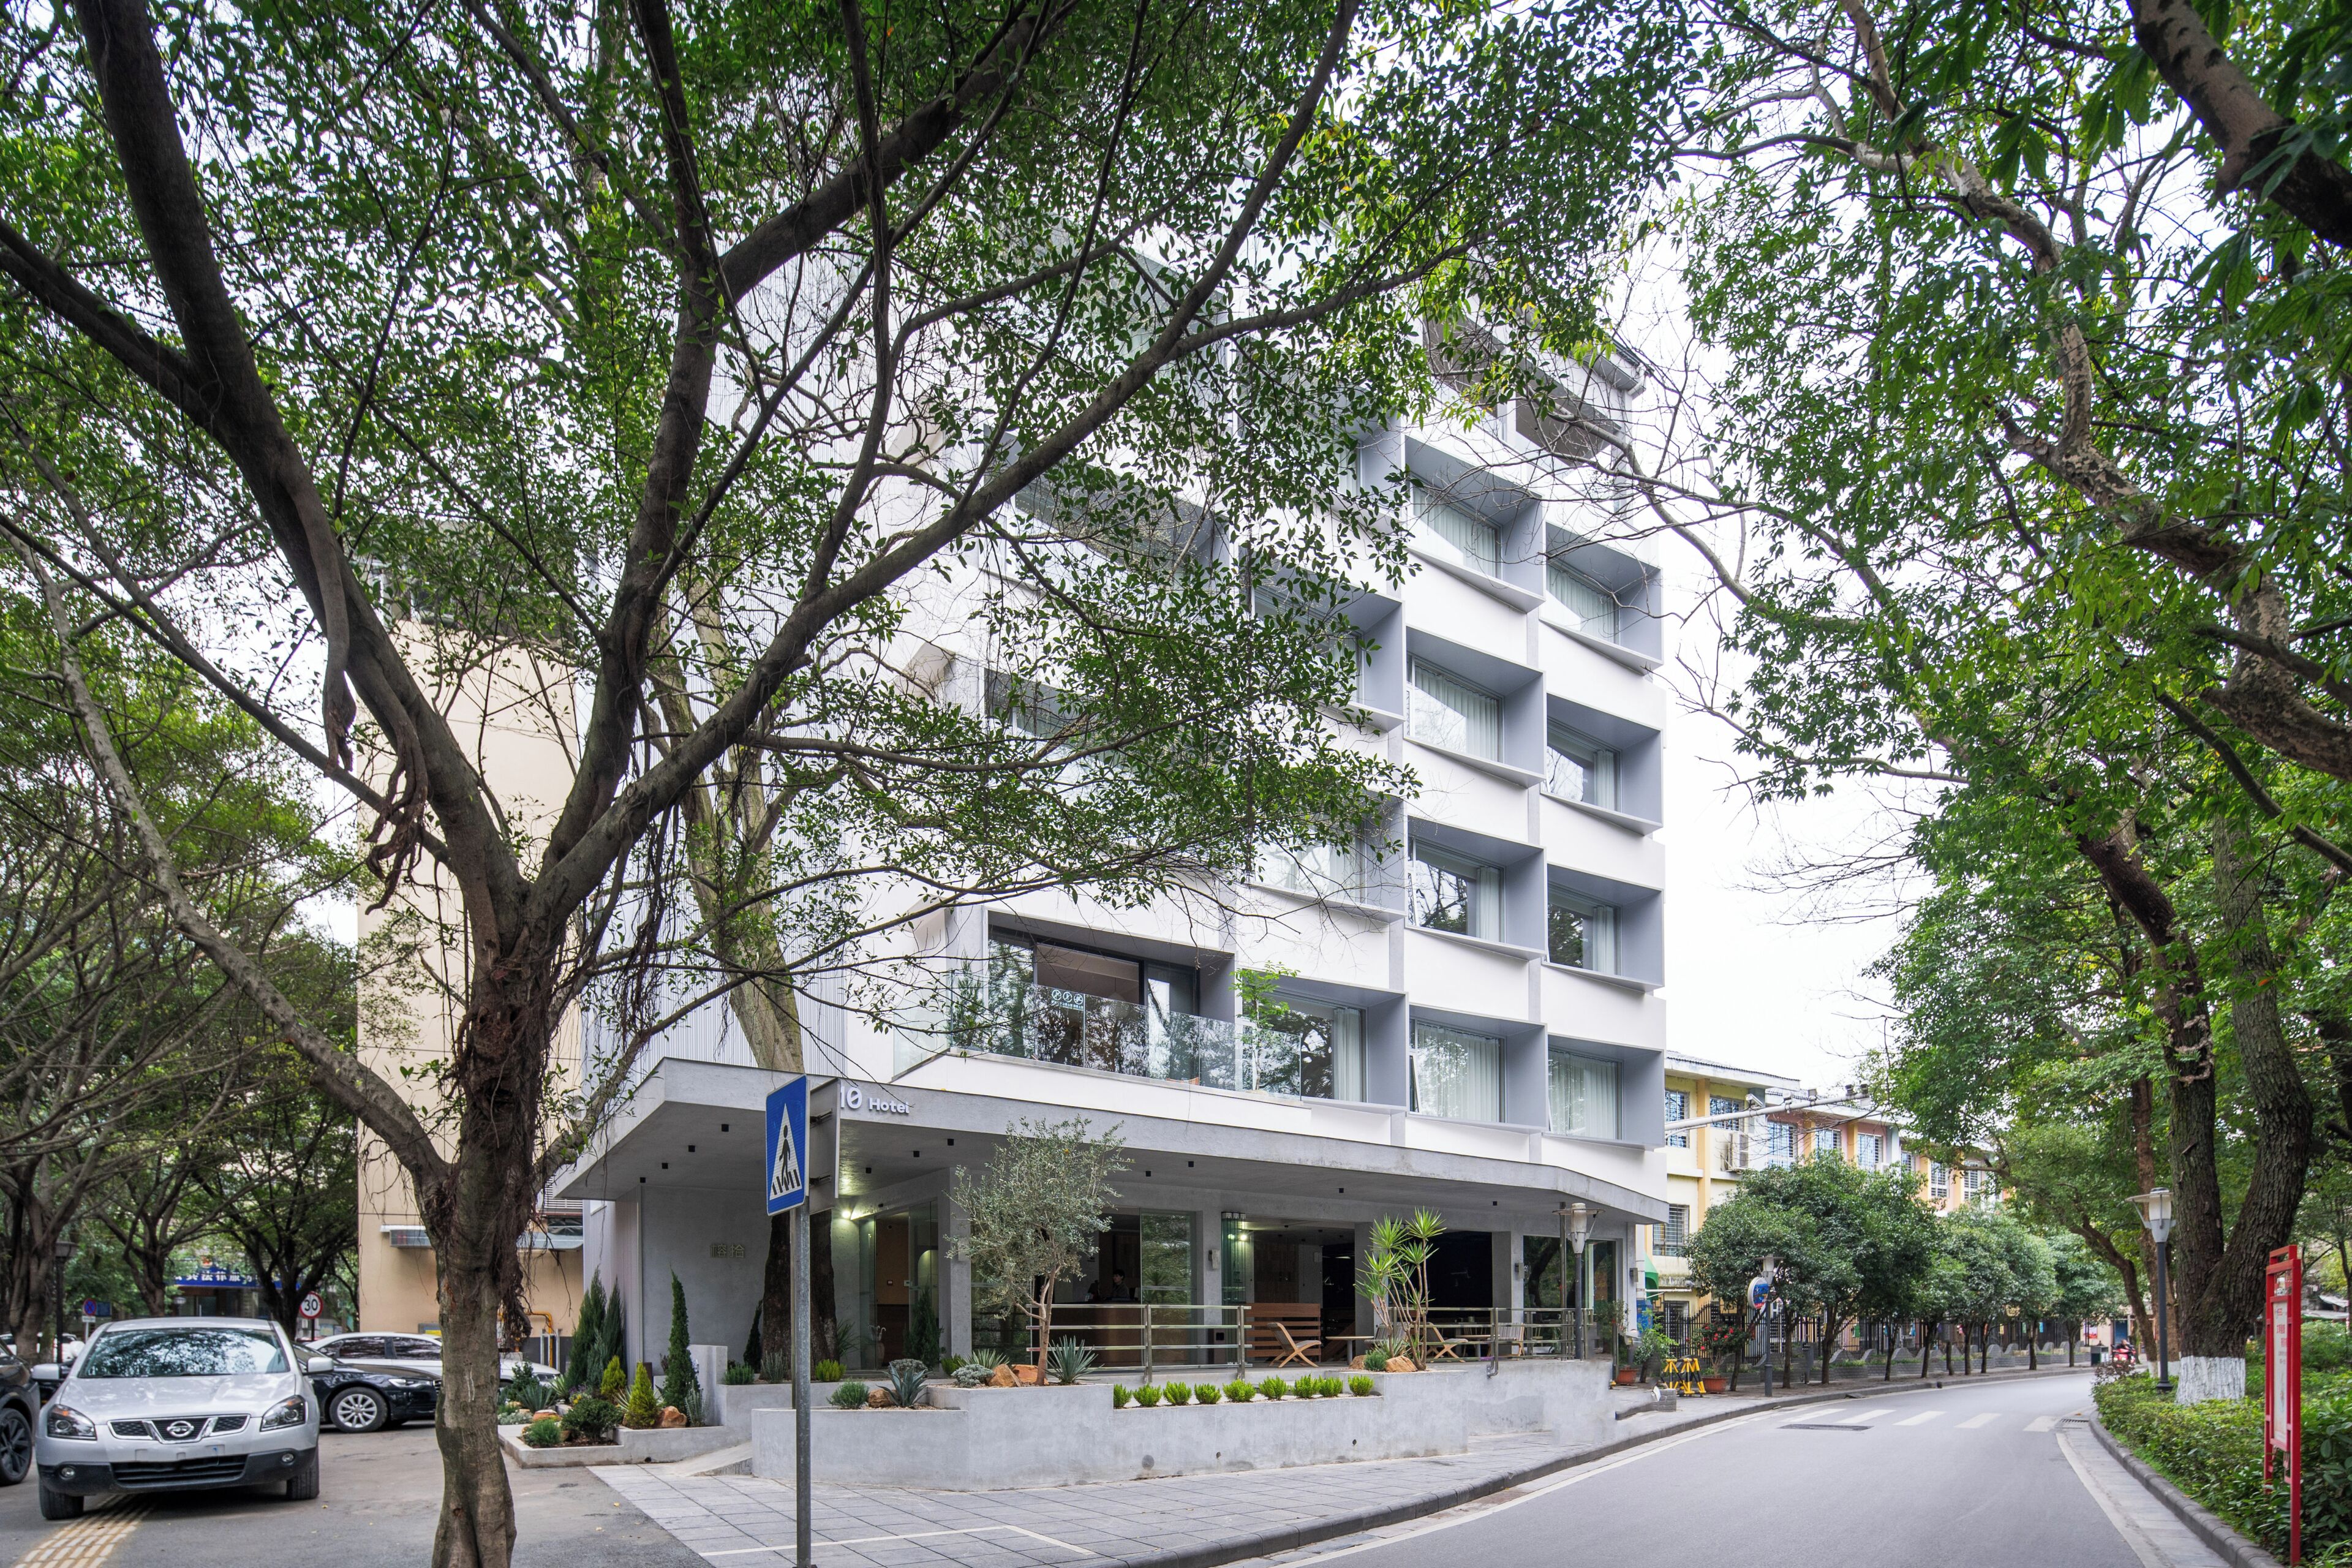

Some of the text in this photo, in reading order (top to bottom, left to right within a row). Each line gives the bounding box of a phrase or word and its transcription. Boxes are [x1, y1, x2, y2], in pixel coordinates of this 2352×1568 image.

[869, 1097, 910, 1114] Hotel
[710, 1243, 745, 1258] 榕拾
[304, 1298, 318, 1311] 30
